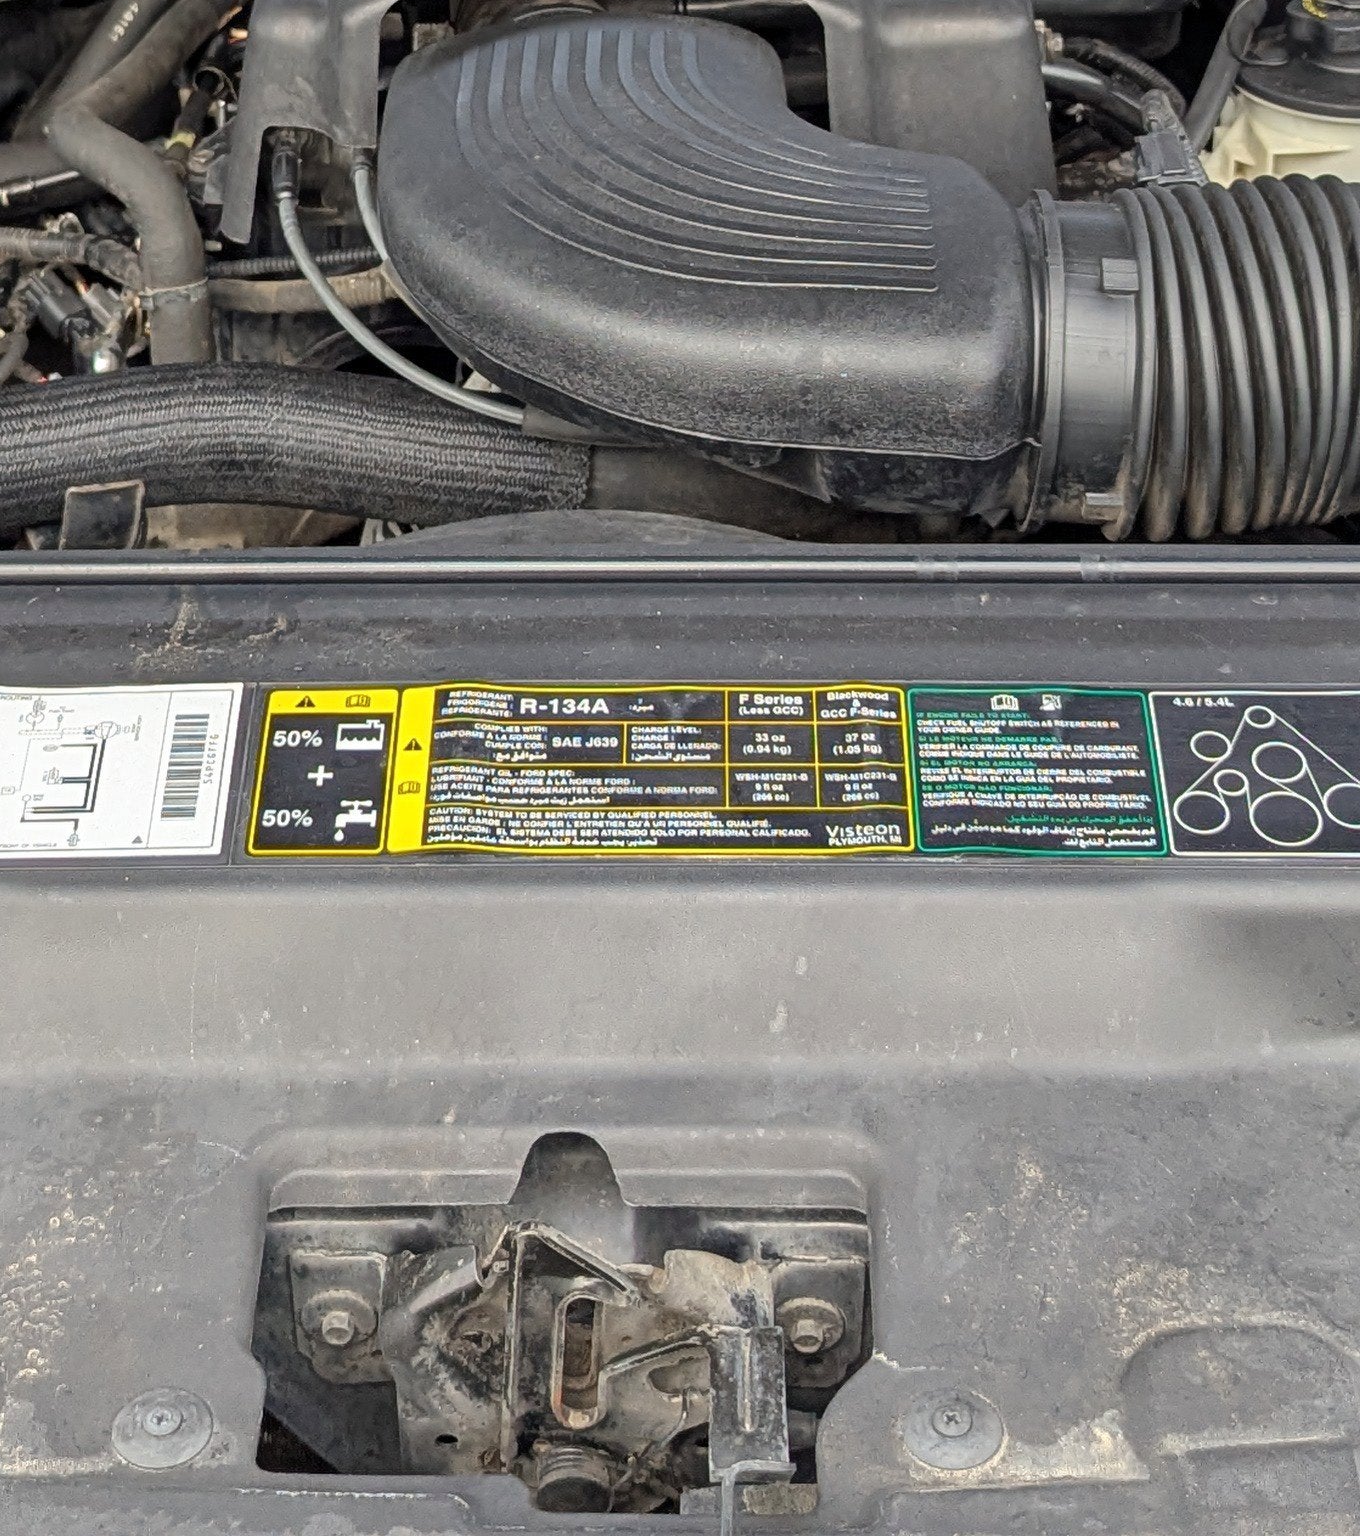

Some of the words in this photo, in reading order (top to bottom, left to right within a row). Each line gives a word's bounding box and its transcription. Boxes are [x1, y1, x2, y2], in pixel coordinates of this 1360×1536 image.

[739, 694, 749, 704] F
[754, 694, 802, 704] Series
[827, 691, 889, 701] Blackwood
[520, 698, 609, 714] R-134A
[739, 707, 770, 716] (Less
[850, 707, 897, 719] F-Series
[273, 729, 323, 749] 50%
[552, 737, 581, 747] SAE
[585, 737, 618, 747] J639
[755, 733, 769, 742] 33
[845, 733, 858, 742] 37
[861, 733, 875, 741] oz
[743, 745, 770, 754] (0.94
[773, 744, 791, 754] kg)
[833, 745, 860, 754] (1.05
[863, 744, 882, 754] kg)
[432, 766, 495, 776] REFRIGERANT
[262, 808, 313, 828] 50%
[476, 809, 512, 818] SYSTEM
[825, 824, 900, 838] Visteon
[828, 836, 887, 846] PLYMOUTH,
